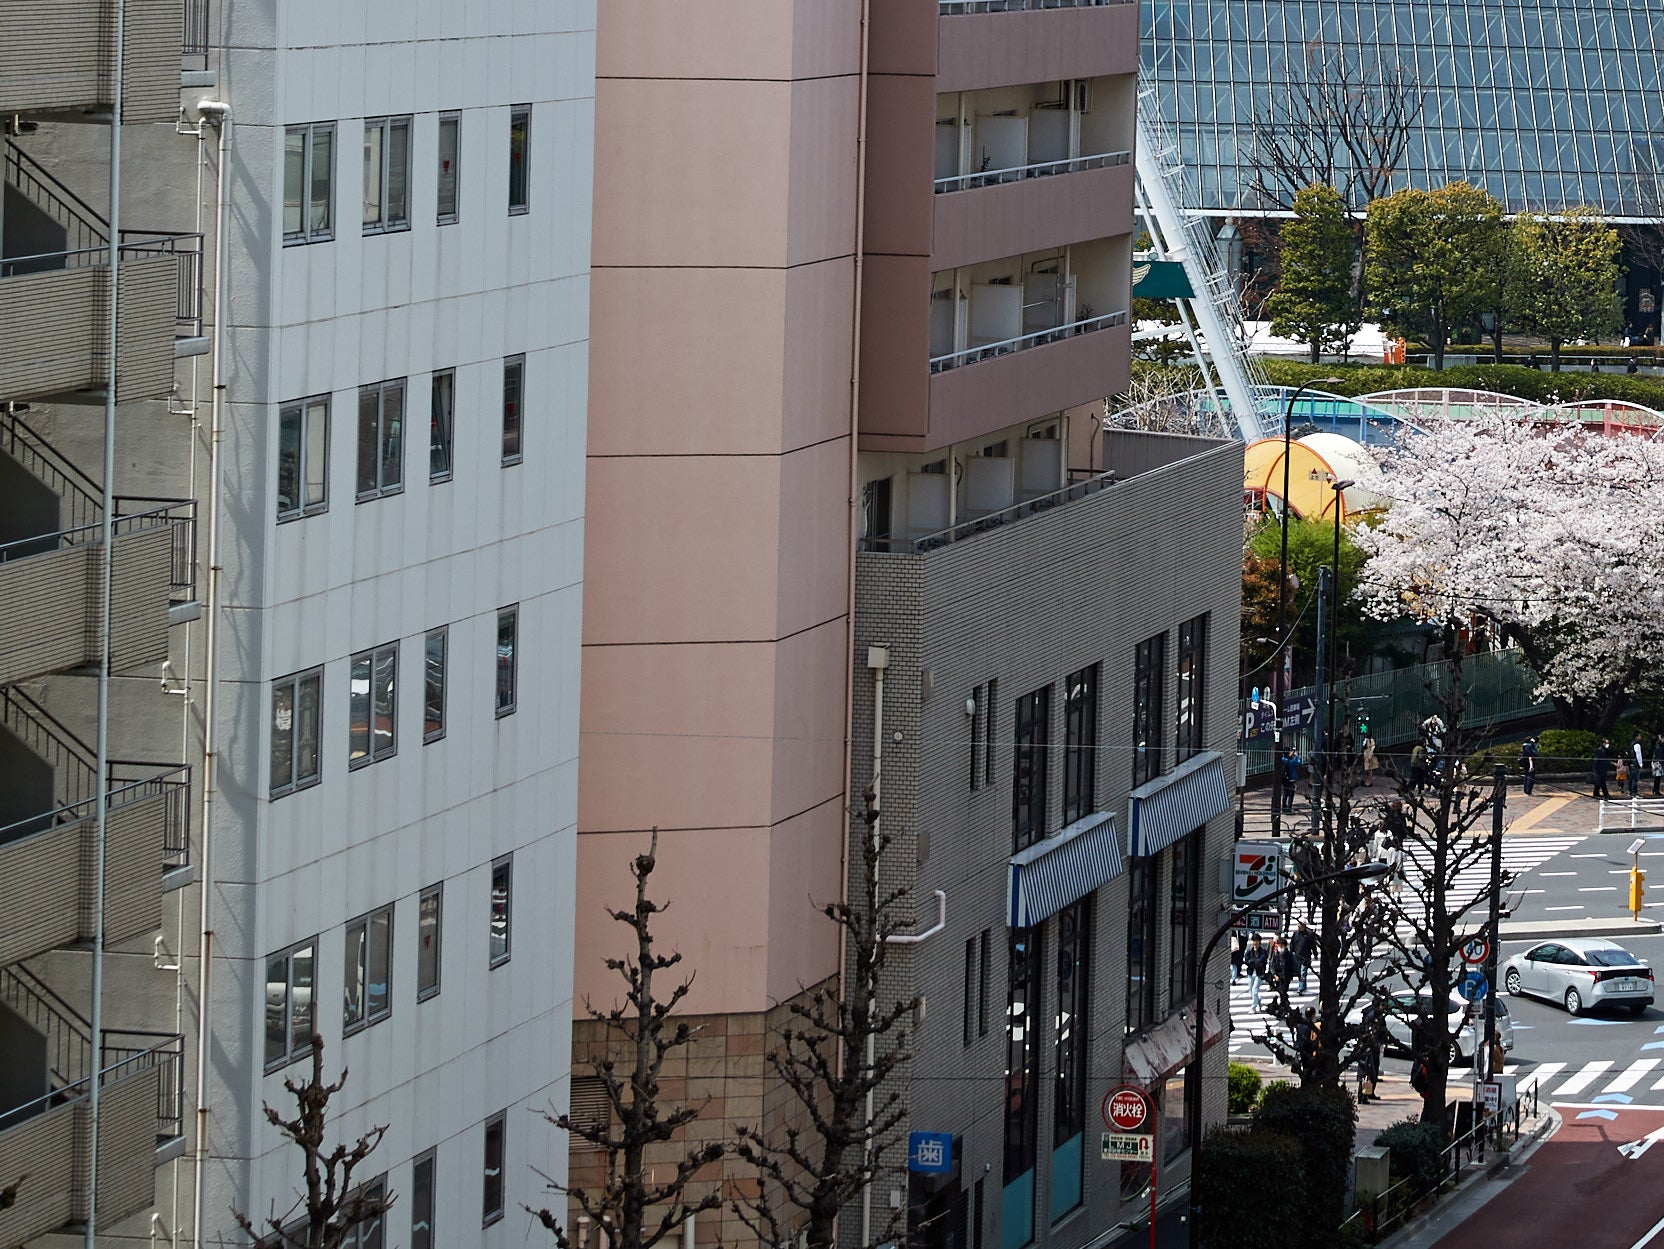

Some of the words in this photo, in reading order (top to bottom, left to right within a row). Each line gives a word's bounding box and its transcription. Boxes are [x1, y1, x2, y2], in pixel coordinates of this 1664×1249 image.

[1245, 711, 1255, 739] P
[1250, 916, 1260, 927] 酒
[1264, 917, 1279, 928] ATM
[1113, 1102, 1143, 1118] 消火栓
[1109, 1141, 1132, 1149] LMJ
[917, 1139, 944, 1166] 歯
